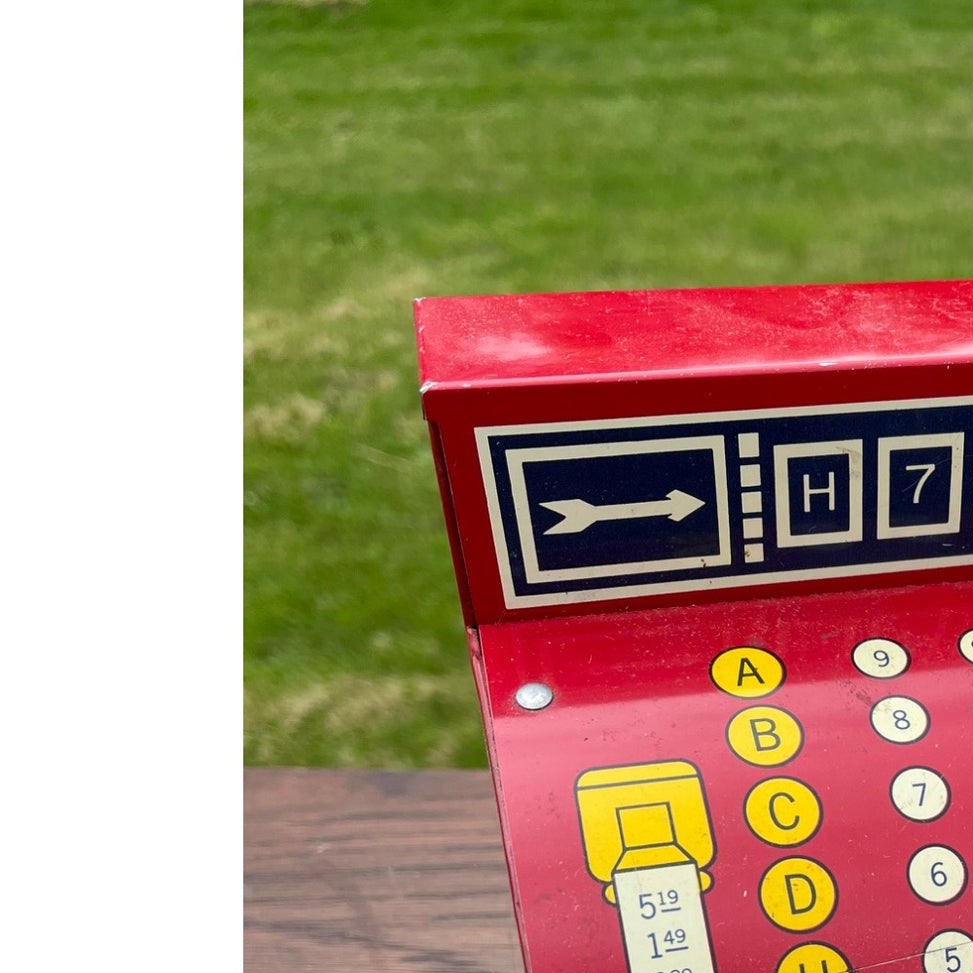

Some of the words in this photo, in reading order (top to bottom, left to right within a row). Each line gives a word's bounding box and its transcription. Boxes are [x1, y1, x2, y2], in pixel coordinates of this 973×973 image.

[802, 471, 837, 512] H
[904, 464, 936, 504] 7
[736, 657, 765, 687] A
[873, 650, 890, 668] 9
[892, 710, 911, 730] 8
[749, 717, 782, 752] B
[911, 782, 927, 807] 7
[767, 791, 801, 831] C
[929, 861, 948, 887] 6
[784, 873, 818, 916] D
[943, 947, 962, 973] 5
